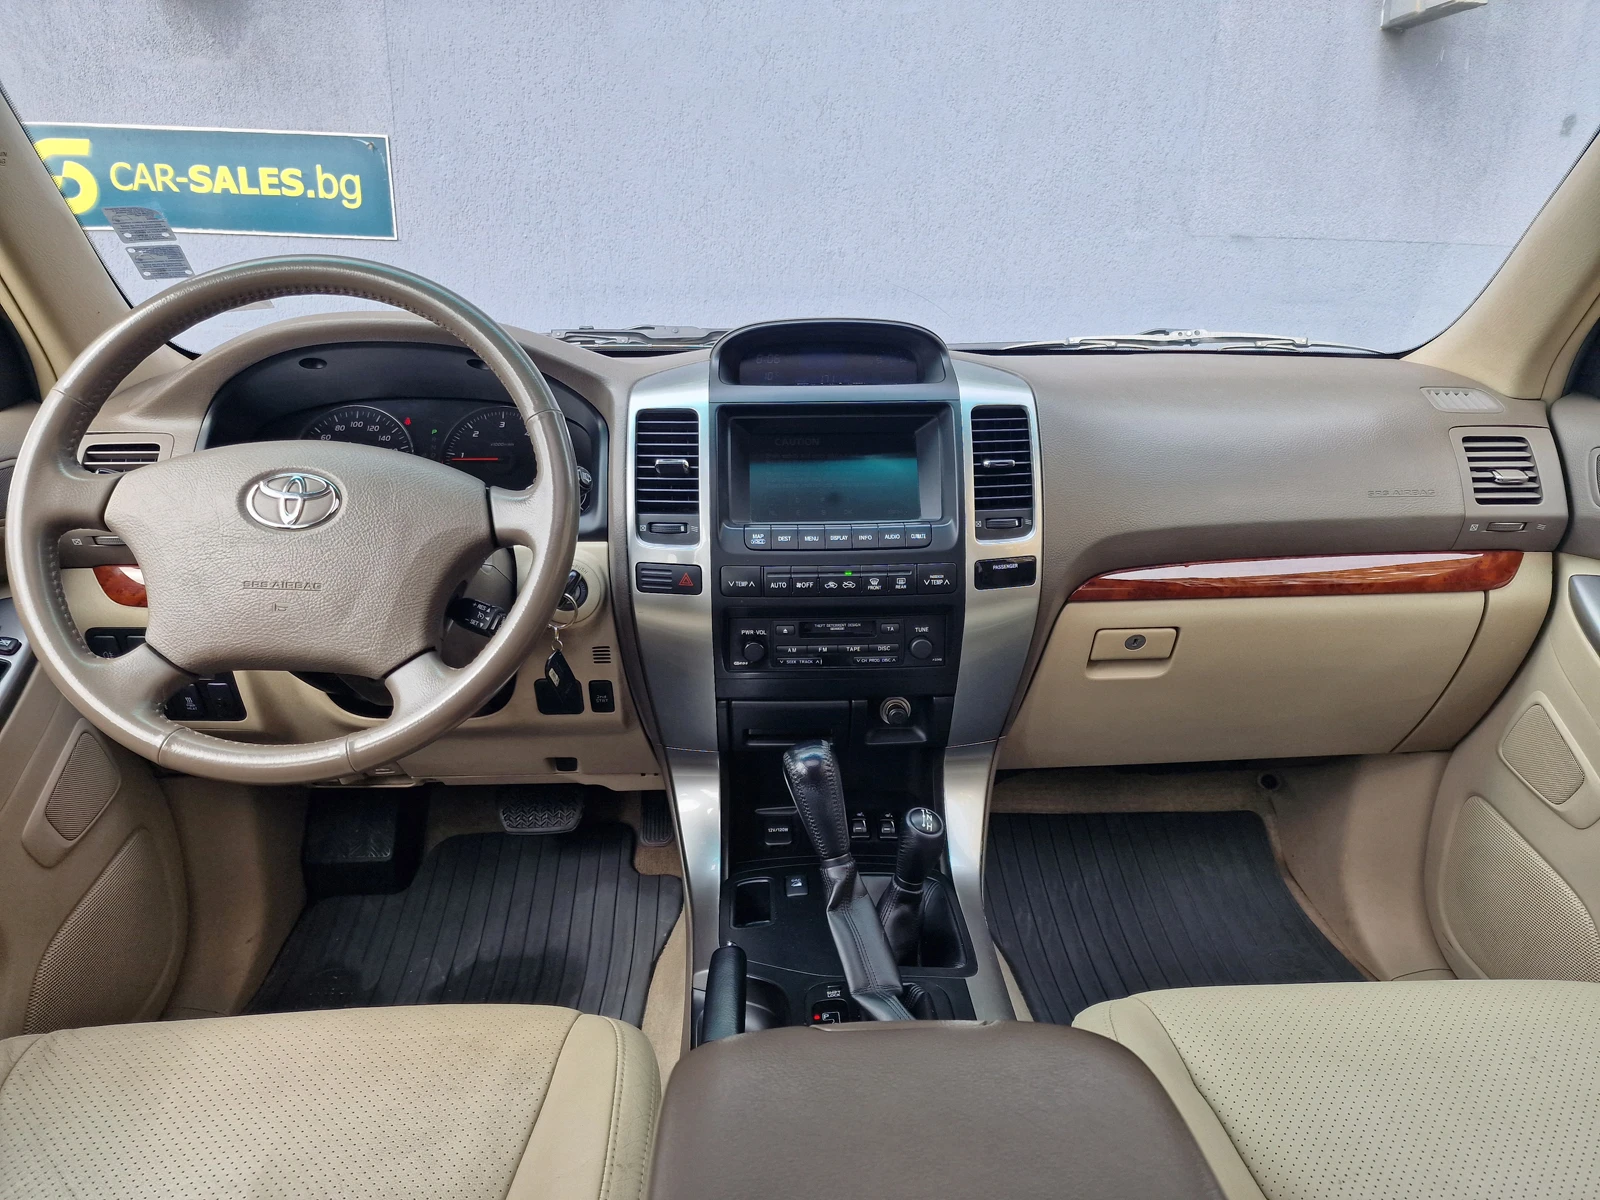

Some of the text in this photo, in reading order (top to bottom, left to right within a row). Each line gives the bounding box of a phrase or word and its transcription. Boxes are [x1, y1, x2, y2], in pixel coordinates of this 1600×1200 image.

[110, 162, 362, 209] CAR-SALES.bg
[335, 424, 345, 432] 80
[775, 438, 819, 446] CAUTION
[272, 581, 321, 590] AIRBAG
[926, 814, 933, 822] N
[926, 822, 933, 832] H
